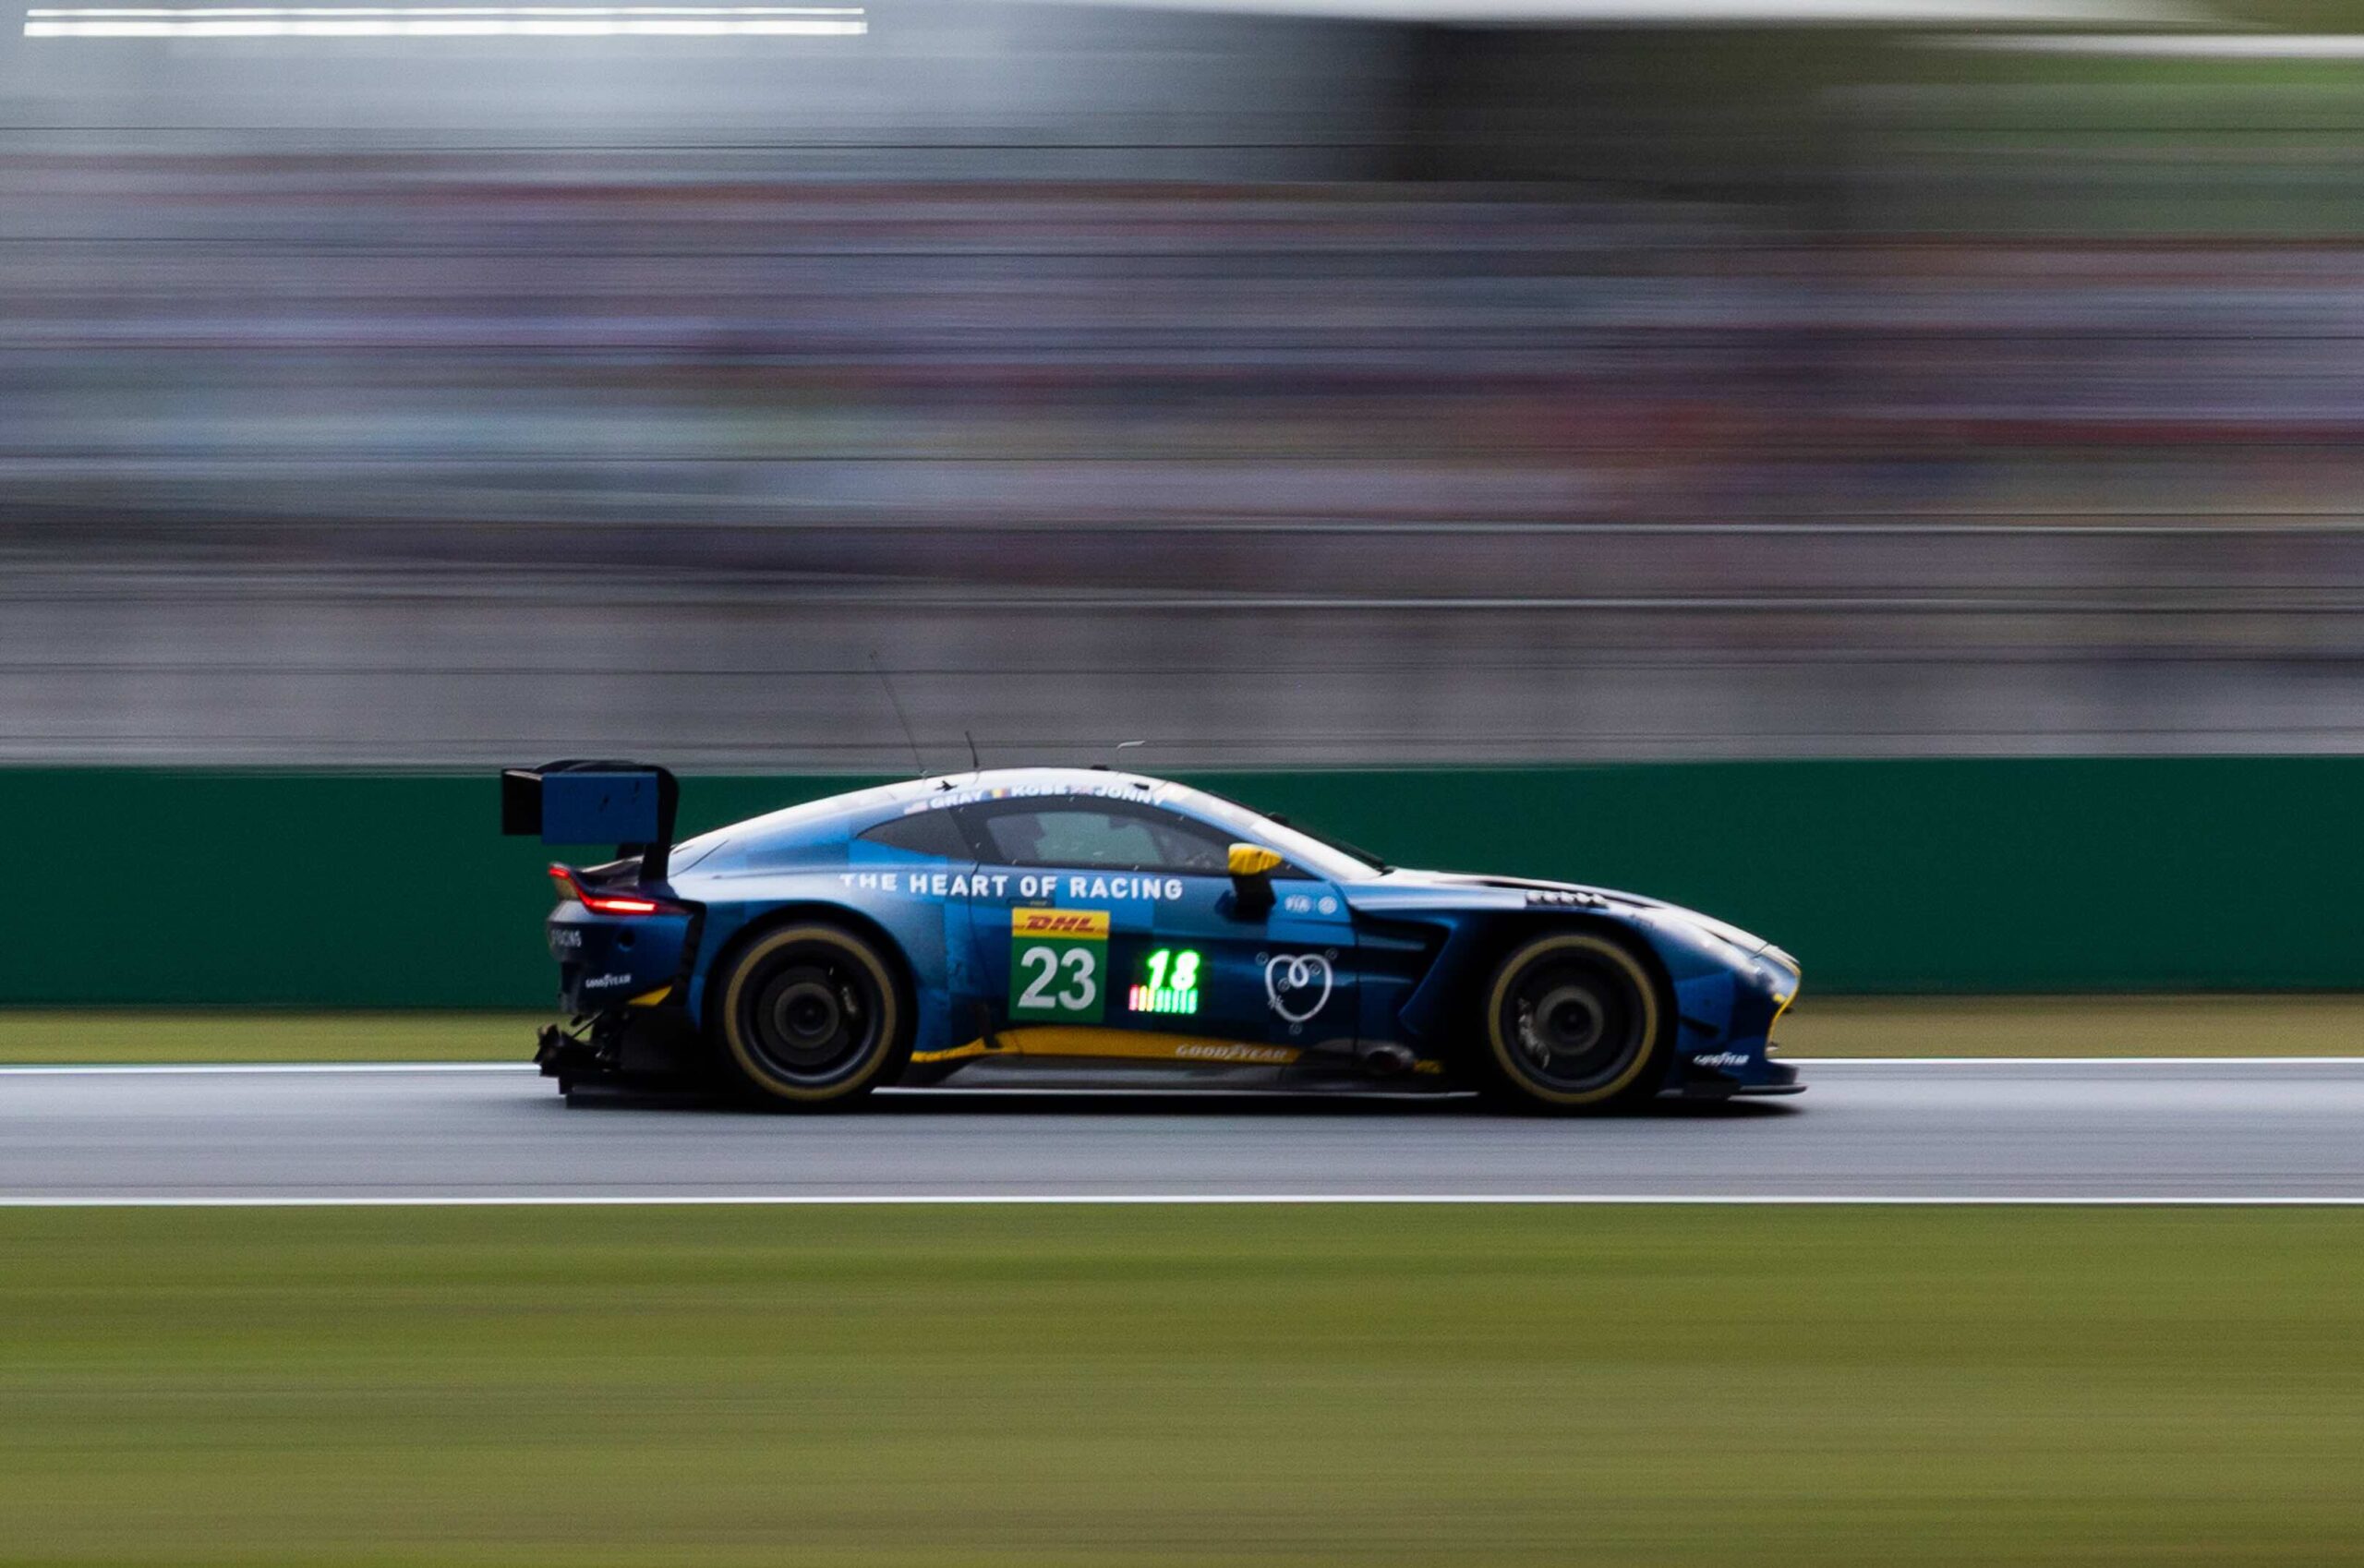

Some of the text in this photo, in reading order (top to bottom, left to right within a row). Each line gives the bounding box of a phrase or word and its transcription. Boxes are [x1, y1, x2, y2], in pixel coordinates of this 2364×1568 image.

[839, 873, 1185, 899] THE HEART OF RACING
[1026, 915, 1095, 932] DHL
[1018, 946, 1097, 1010] 23
[1146, 947, 1200, 992] 18
[1176, 1043, 1288, 1059] GOODYEAR
